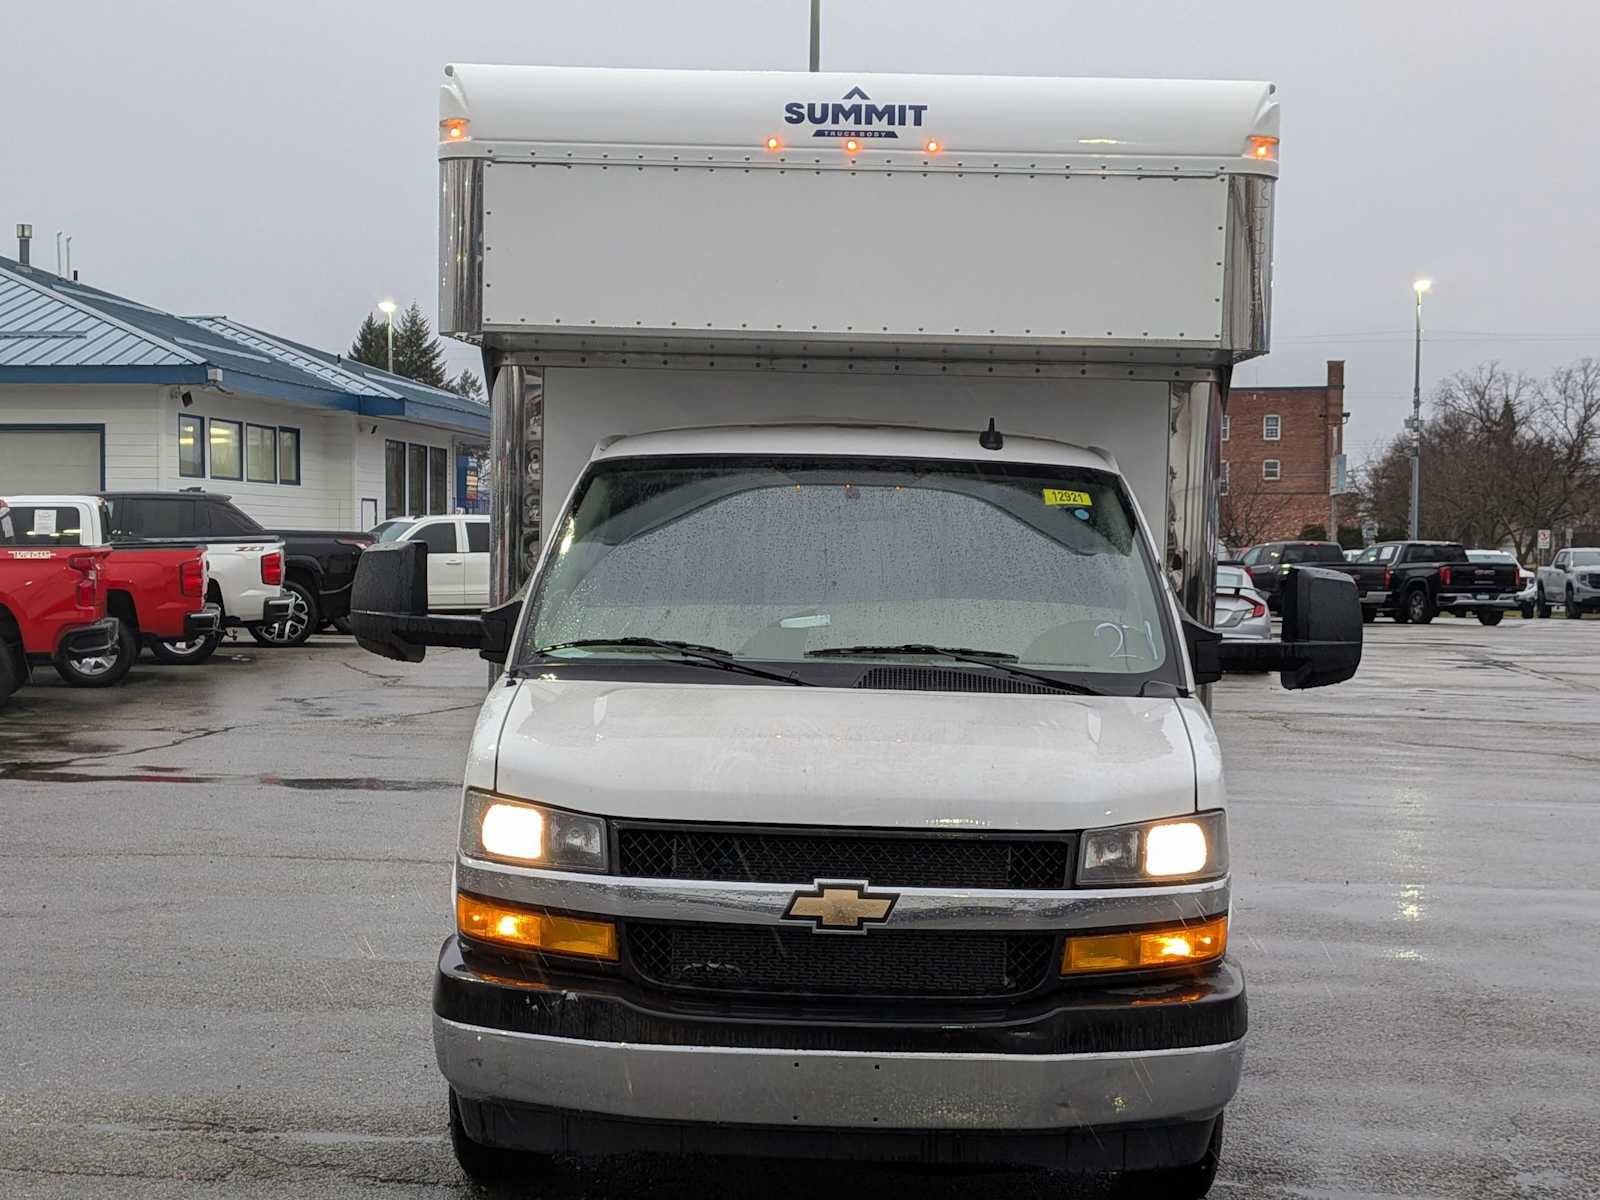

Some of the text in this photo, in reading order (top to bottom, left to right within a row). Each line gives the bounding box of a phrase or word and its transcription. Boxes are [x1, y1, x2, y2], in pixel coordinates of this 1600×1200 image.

[784, 102, 928, 127] SUMMIT
[859, 130, 887, 138] BODY
[1051, 491, 1084, 503] 12921
